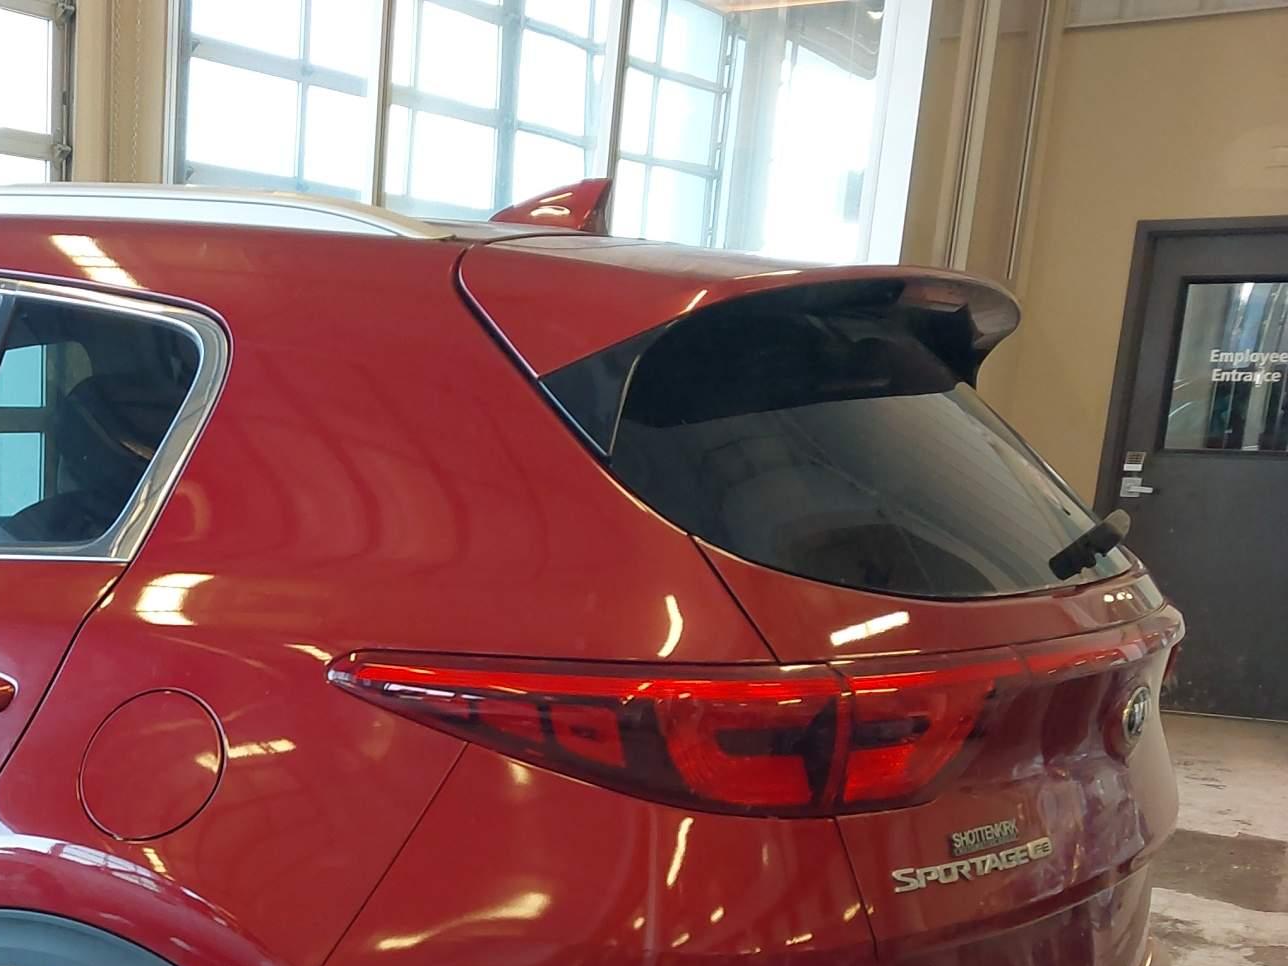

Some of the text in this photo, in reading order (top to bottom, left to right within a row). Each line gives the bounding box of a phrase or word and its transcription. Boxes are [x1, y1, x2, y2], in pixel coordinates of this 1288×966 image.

[1209, 348, 1288, 367] Employee
[1212, 368, 1282, 383] Entrance
[892, 843, 1029, 893] SPORTAGE
